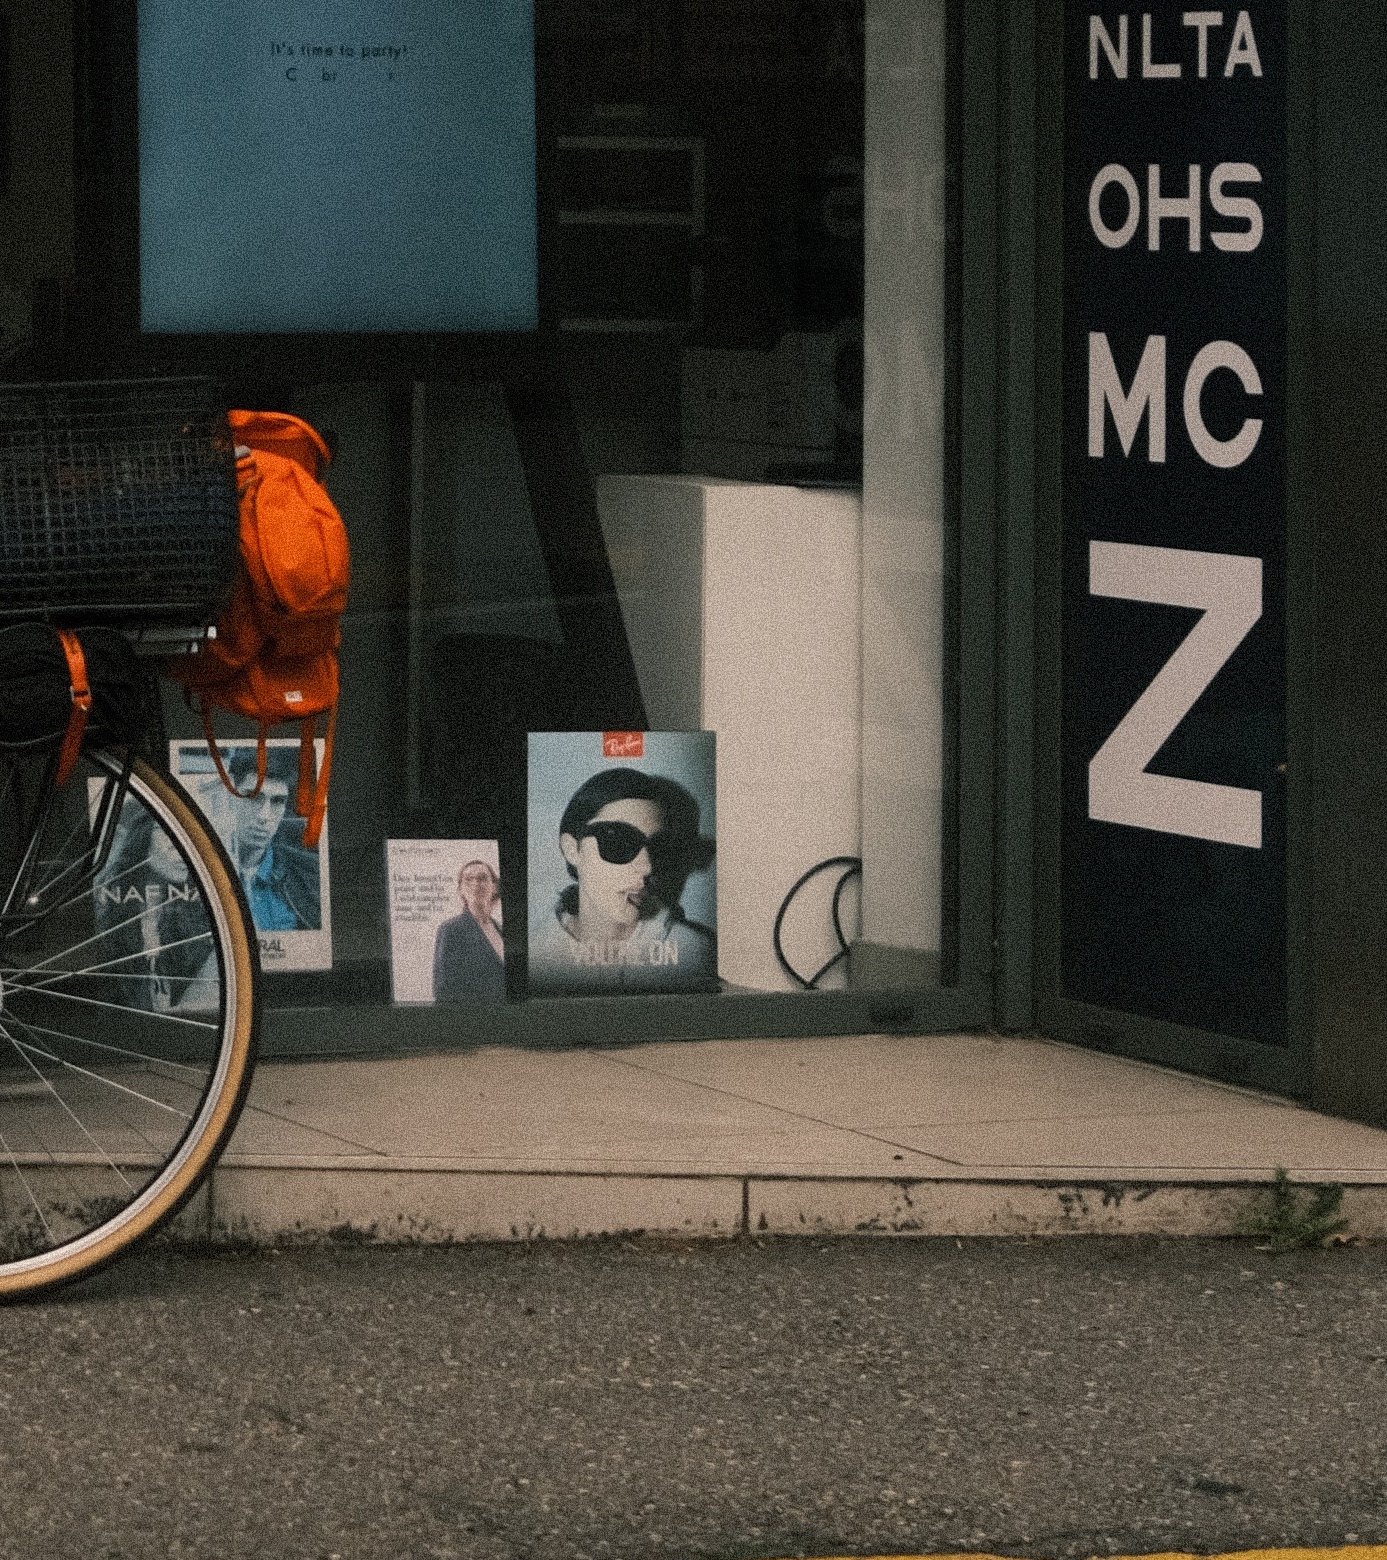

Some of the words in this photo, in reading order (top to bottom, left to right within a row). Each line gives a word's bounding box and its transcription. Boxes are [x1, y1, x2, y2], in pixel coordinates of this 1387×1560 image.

[1089, 10, 1264, 80] NLTA
[1089, 162, 1264, 252] OHS
[1089, 331, 1264, 468] MC
[1089, 540, 1263, 849] Z
[100, 884, 161, 905] NAF
[649, 939, 680, 966] ON
